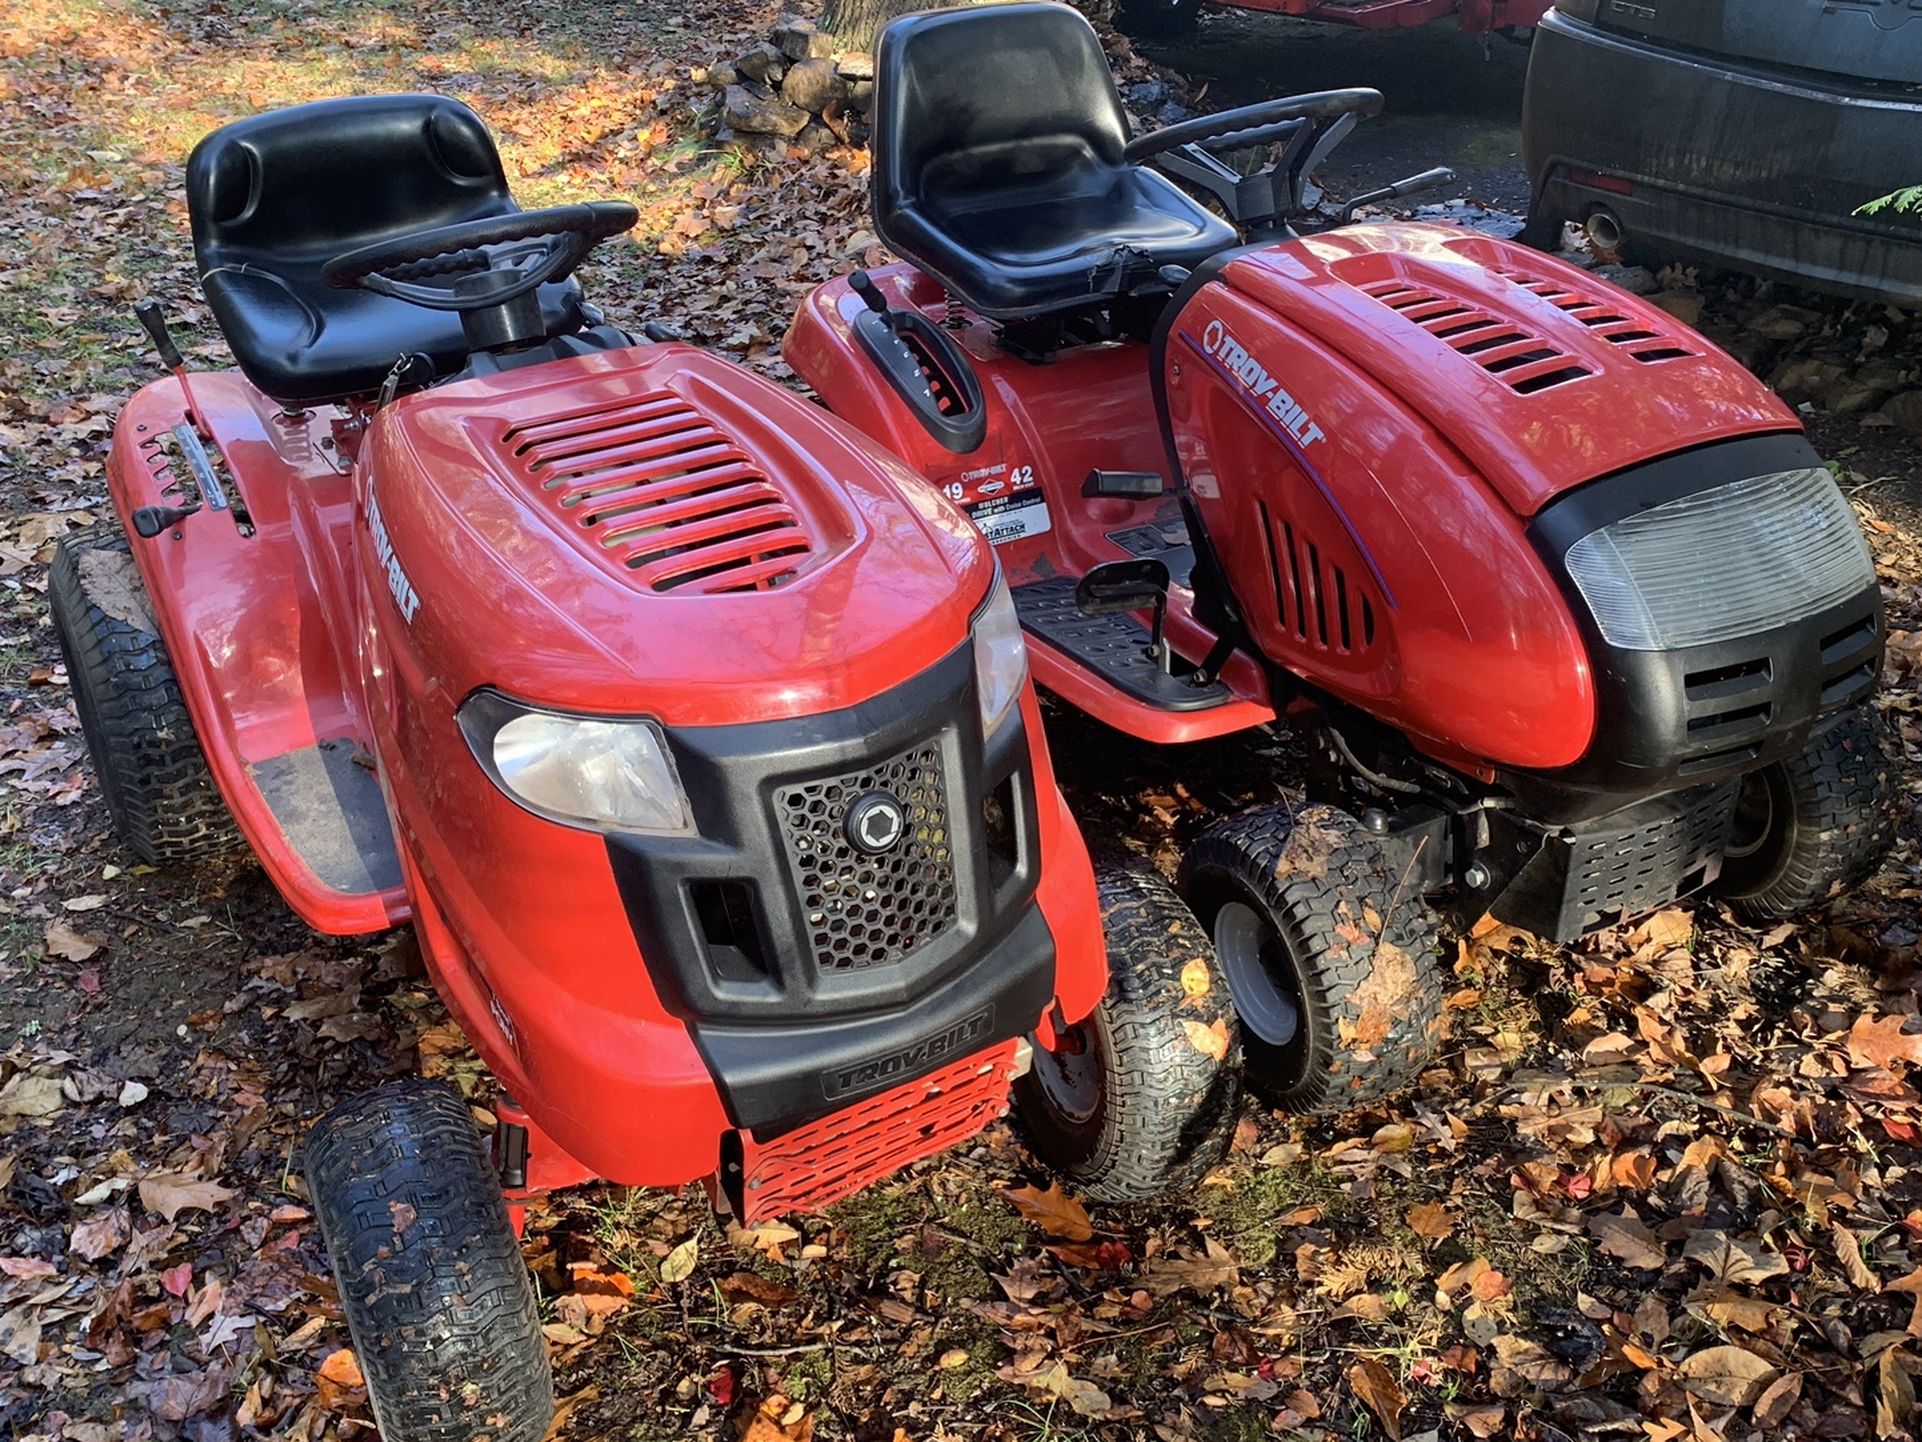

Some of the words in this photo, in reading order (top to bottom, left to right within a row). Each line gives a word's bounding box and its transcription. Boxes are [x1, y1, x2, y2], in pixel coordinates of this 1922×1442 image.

[1216, 334, 1326, 450] TROY-BILT
[942, 482, 963, 500] 19
[1010, 465, 1034, 484] 42
[368, 493, 421, 625] TROY-BILT
[837, 1012, 989, 1091] TROY-BILT
